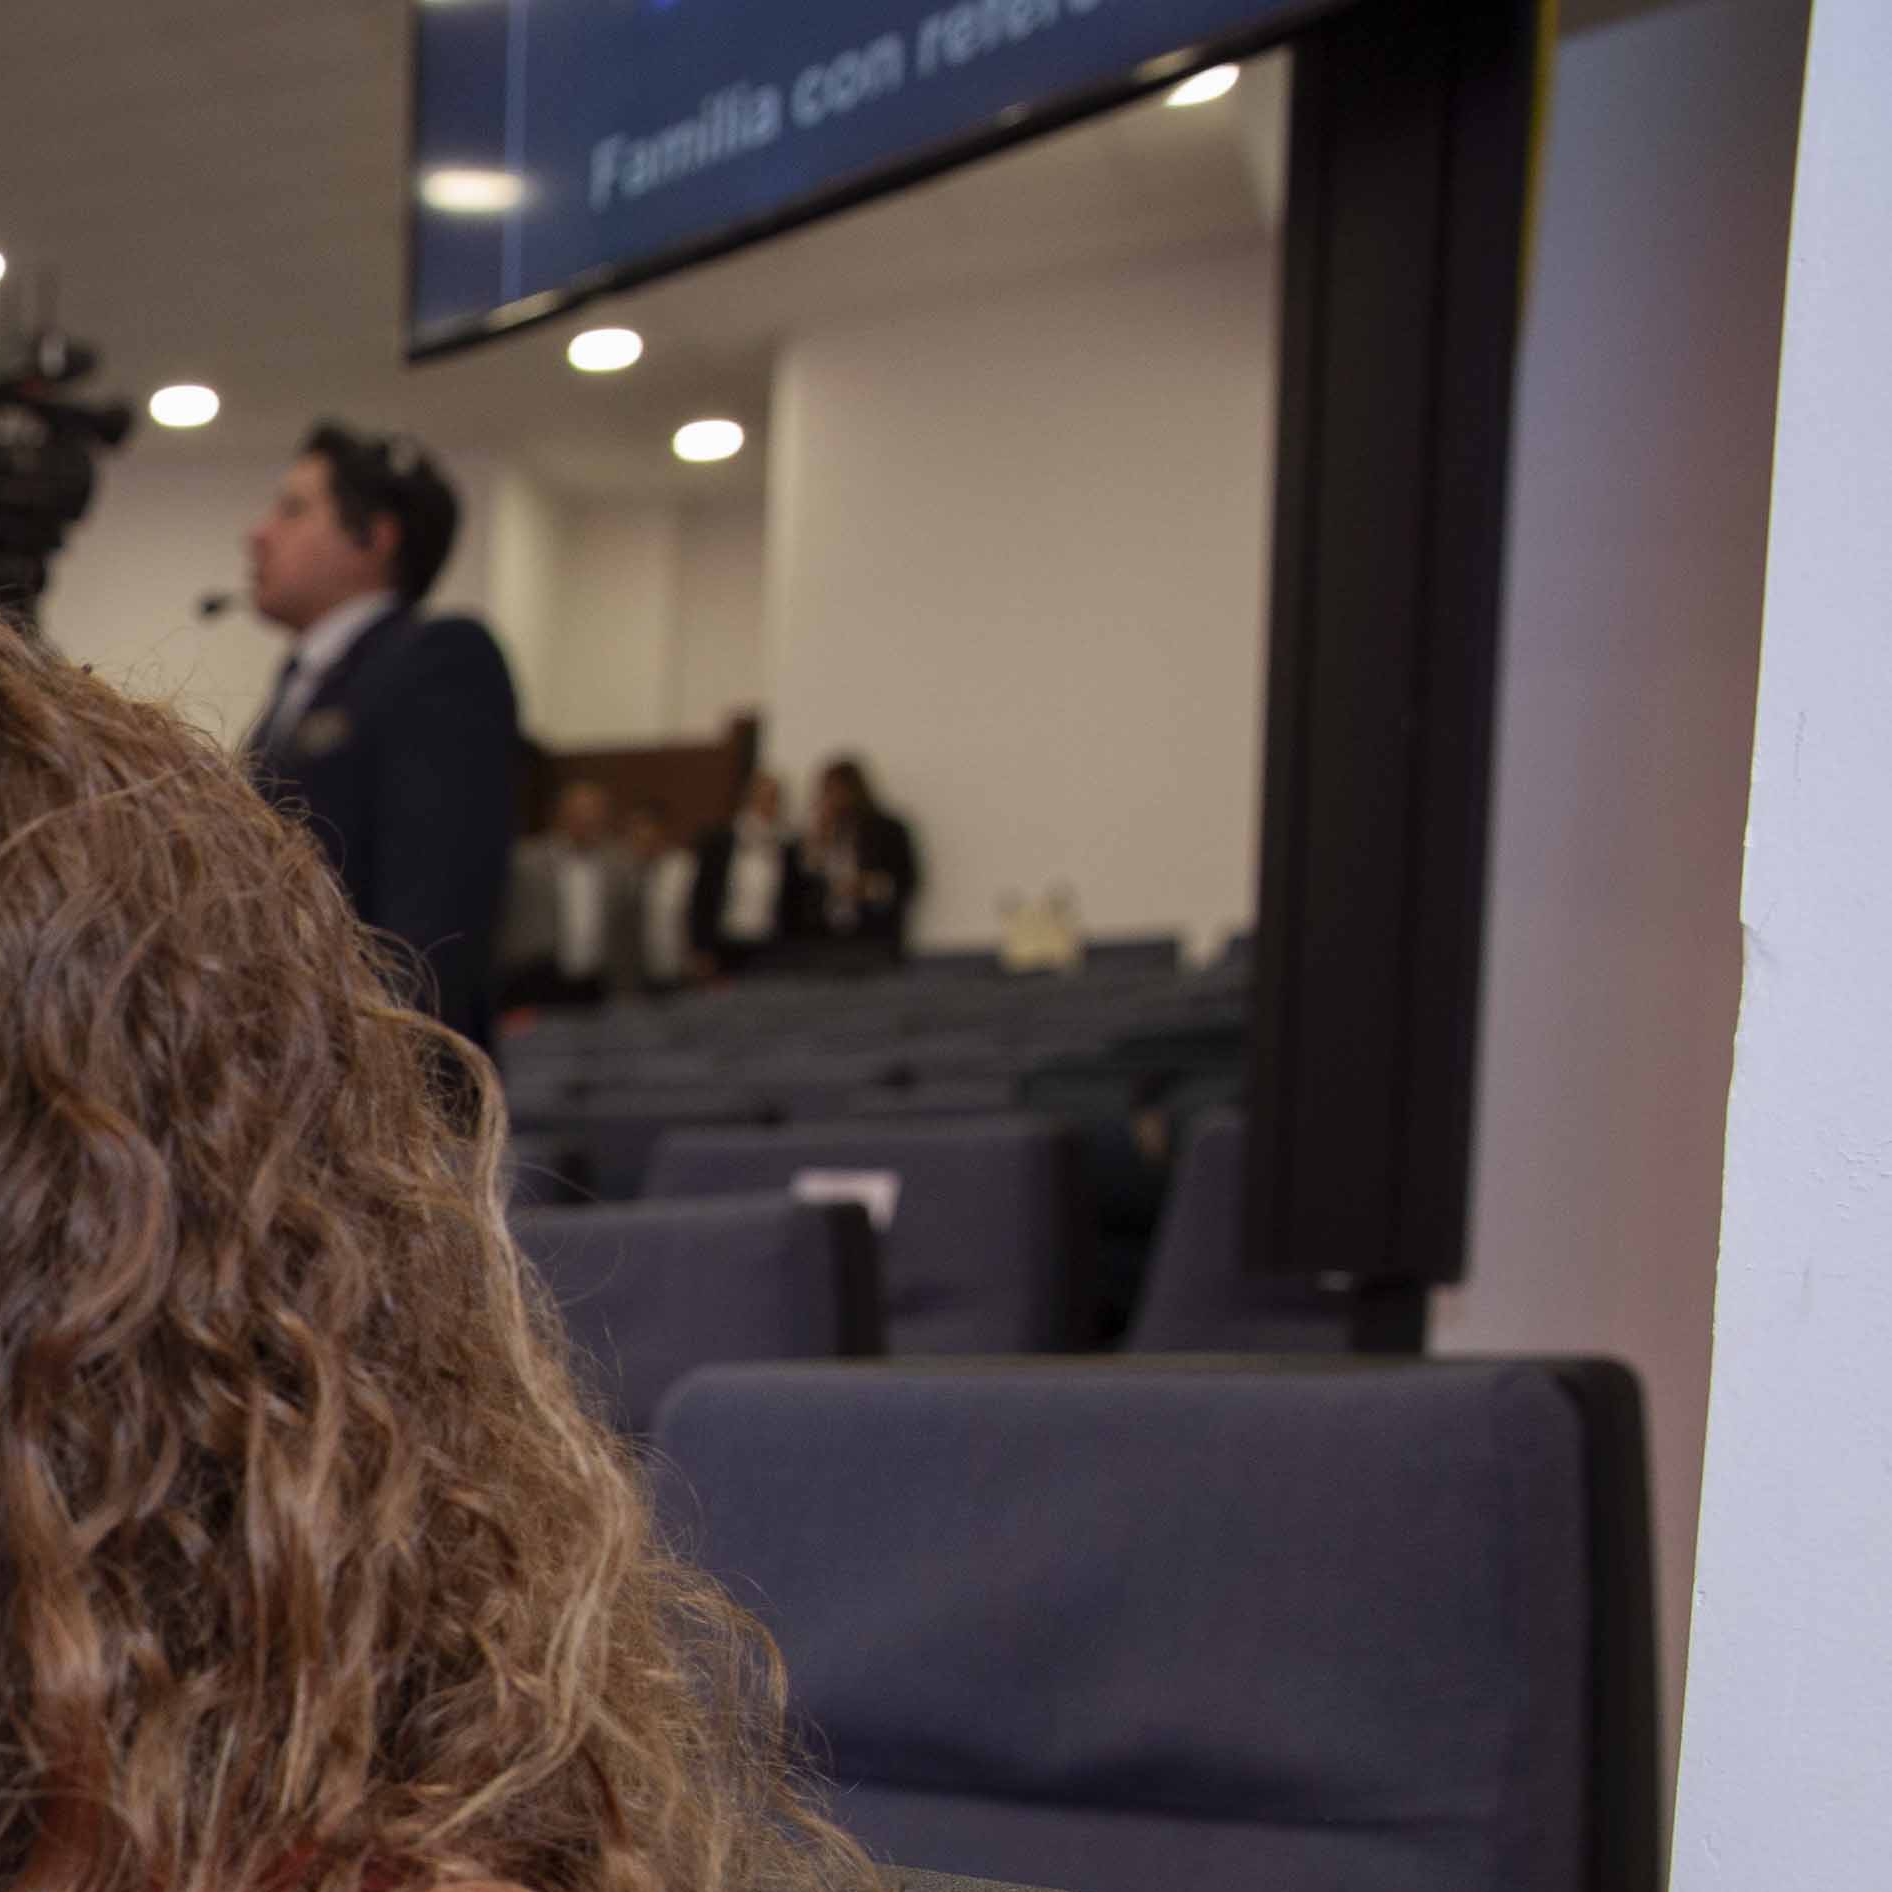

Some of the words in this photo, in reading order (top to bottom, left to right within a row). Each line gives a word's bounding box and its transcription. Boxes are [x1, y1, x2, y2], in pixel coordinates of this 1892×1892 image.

[588, 82, 784, 212] Familia
[790, 32, 907, 127] con
[917, 0, 1102, 80] refer
